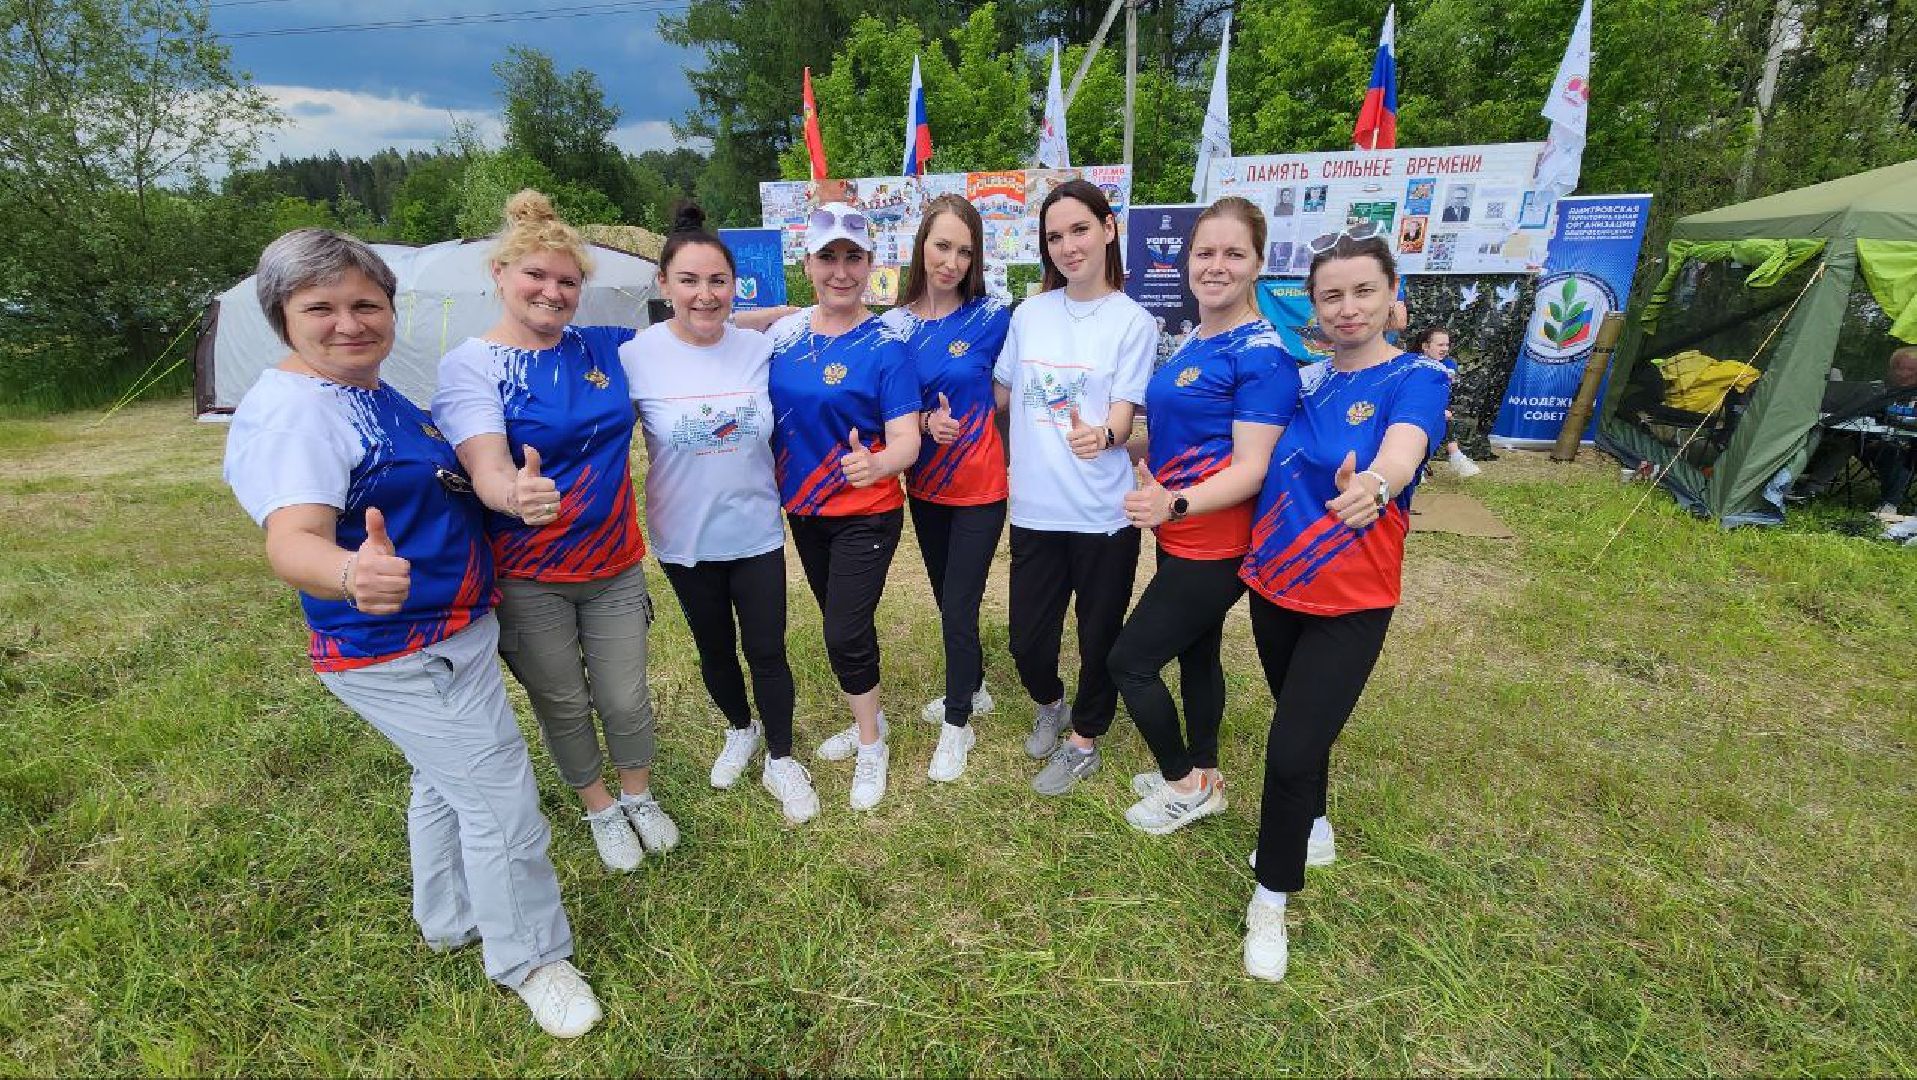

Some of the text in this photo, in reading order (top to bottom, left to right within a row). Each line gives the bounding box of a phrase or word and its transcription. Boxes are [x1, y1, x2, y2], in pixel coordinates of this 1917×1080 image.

[1247, 154, 1481, 182] ПАМЯТЬ СИЛЬНЕЕ ВРЕМЕНИ
[1569, 205, 1639, 215] ДМИТРОВСКАЯ
[1565, 221, 1637, 230] ОРГАНИЗАЦИЯ
[1146, 237, 1183, 245] УСПЕХ
[1523, 410, 1566, 421] СОВЕТ
